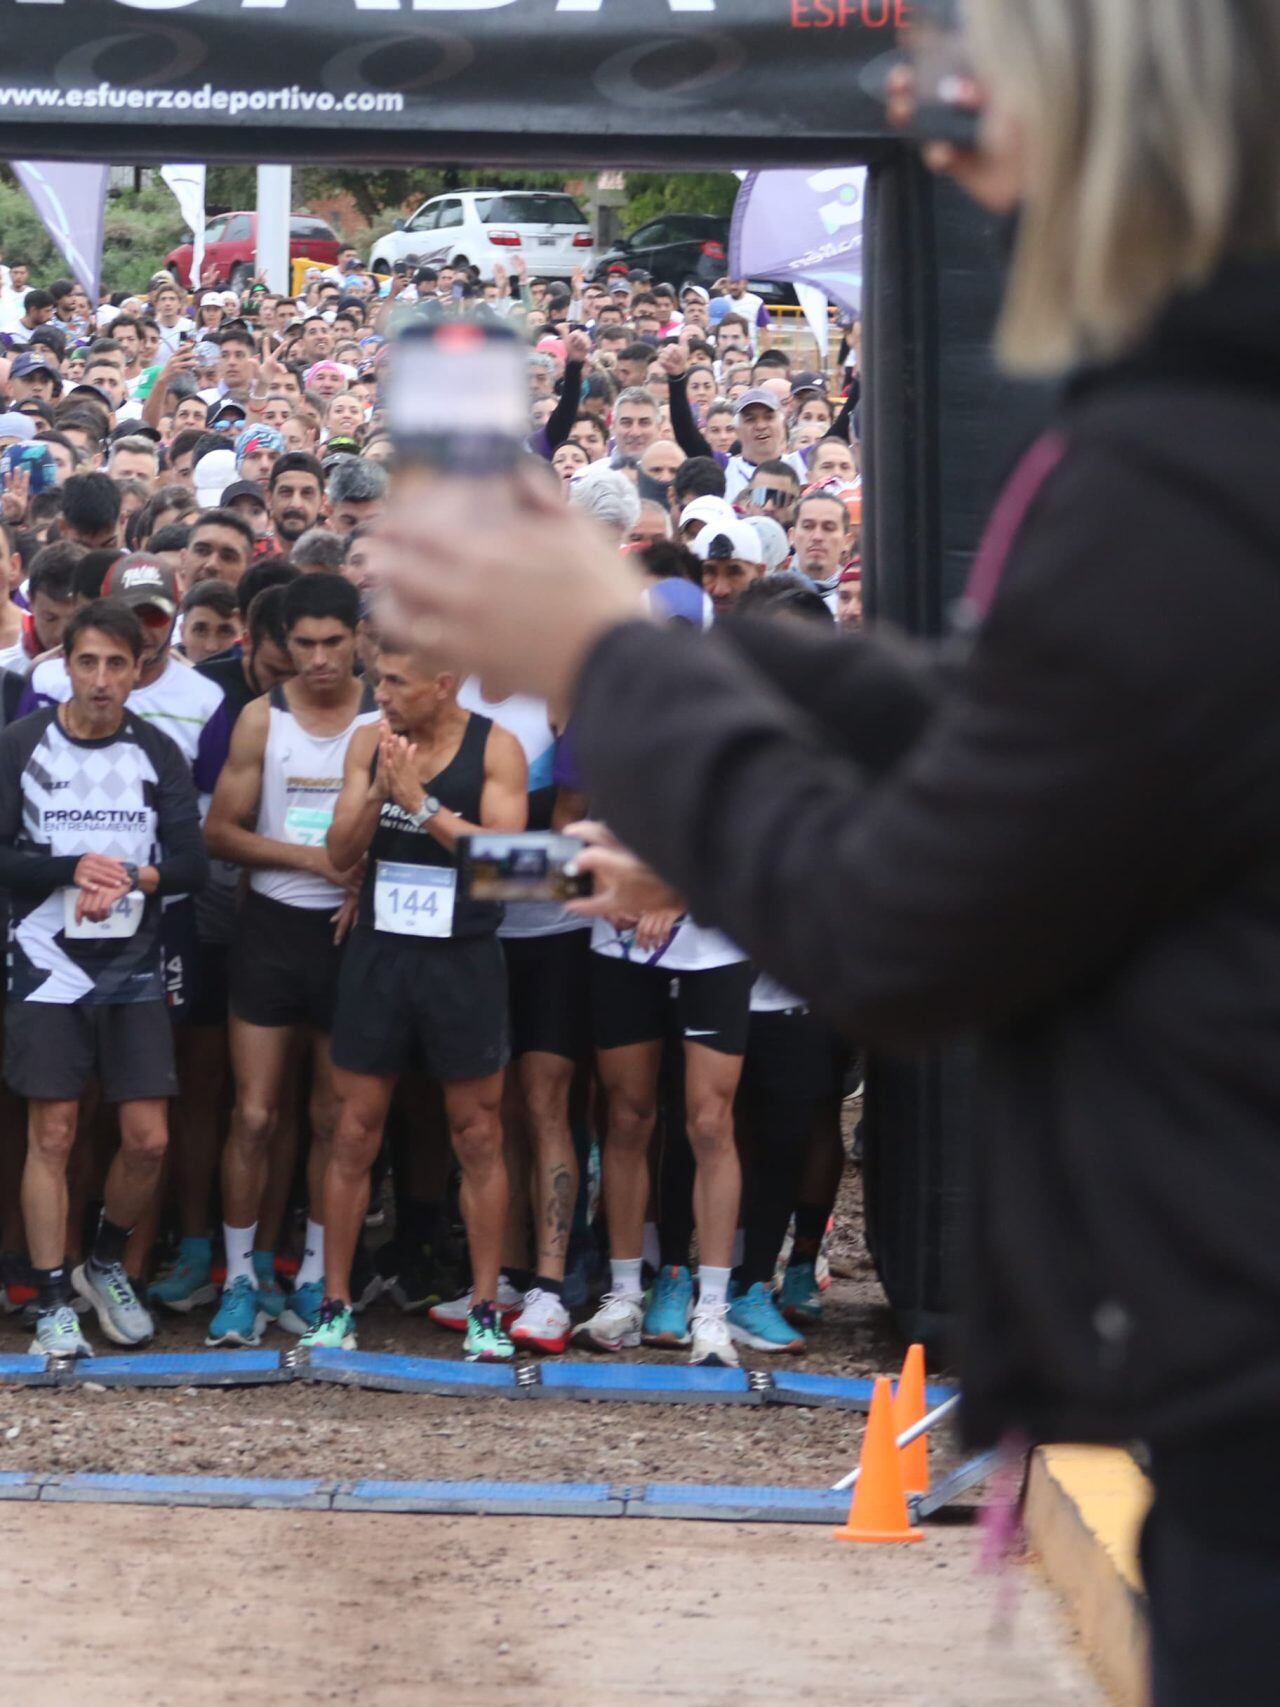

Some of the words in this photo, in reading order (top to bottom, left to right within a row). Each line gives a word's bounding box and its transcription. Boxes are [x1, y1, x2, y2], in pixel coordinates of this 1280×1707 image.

[44, 810, 147, 823] PROACTIVE
[44, 822, 147, 833] ENTRENAMIENTO
[388, 888, 439, 918] 144
[166, 954, 185, 1008] FILA
